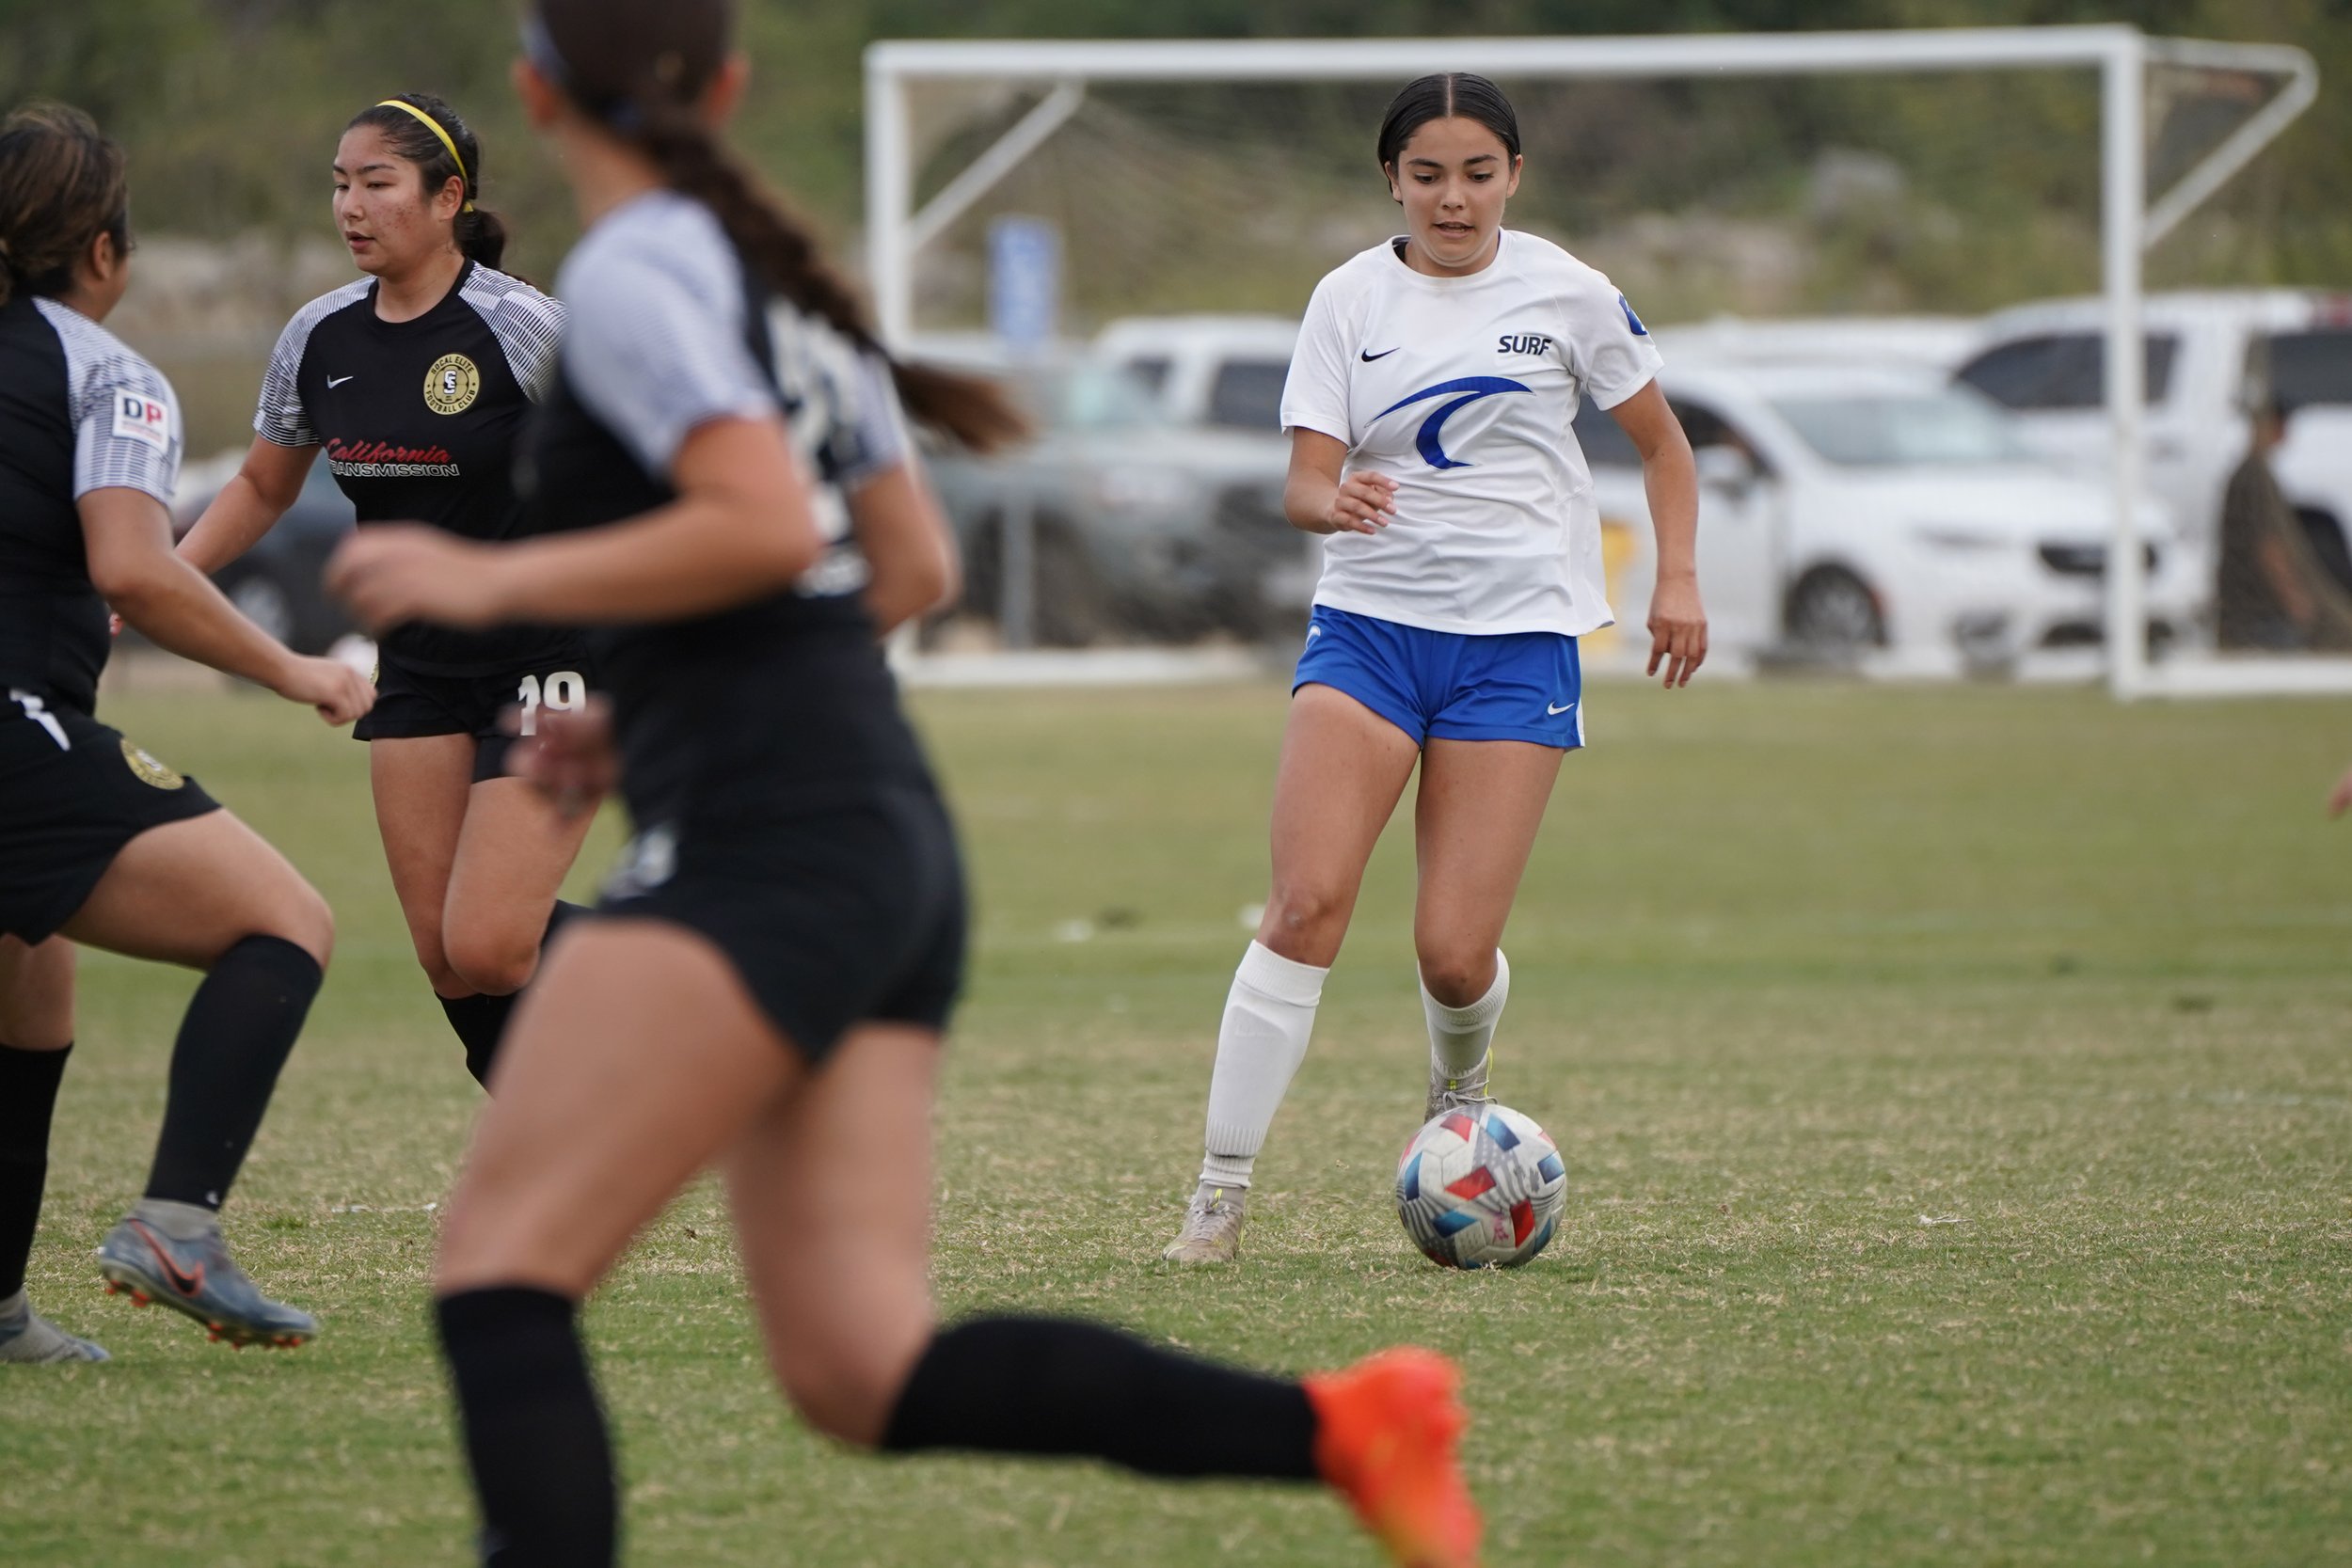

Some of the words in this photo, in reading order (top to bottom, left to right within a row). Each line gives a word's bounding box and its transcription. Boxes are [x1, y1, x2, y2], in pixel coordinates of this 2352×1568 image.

[1497, 335, 1552, 356] SURF
[454, 356, 475, 373] ELITE
[123, 397, 163, 424] DP
[425, 390, 457, 413] FOOTBALL
[458, 389, 476, 409] CLUB
[327, 437, 452, 464] California
[328, 458, 460, 477] ANSMISSION
